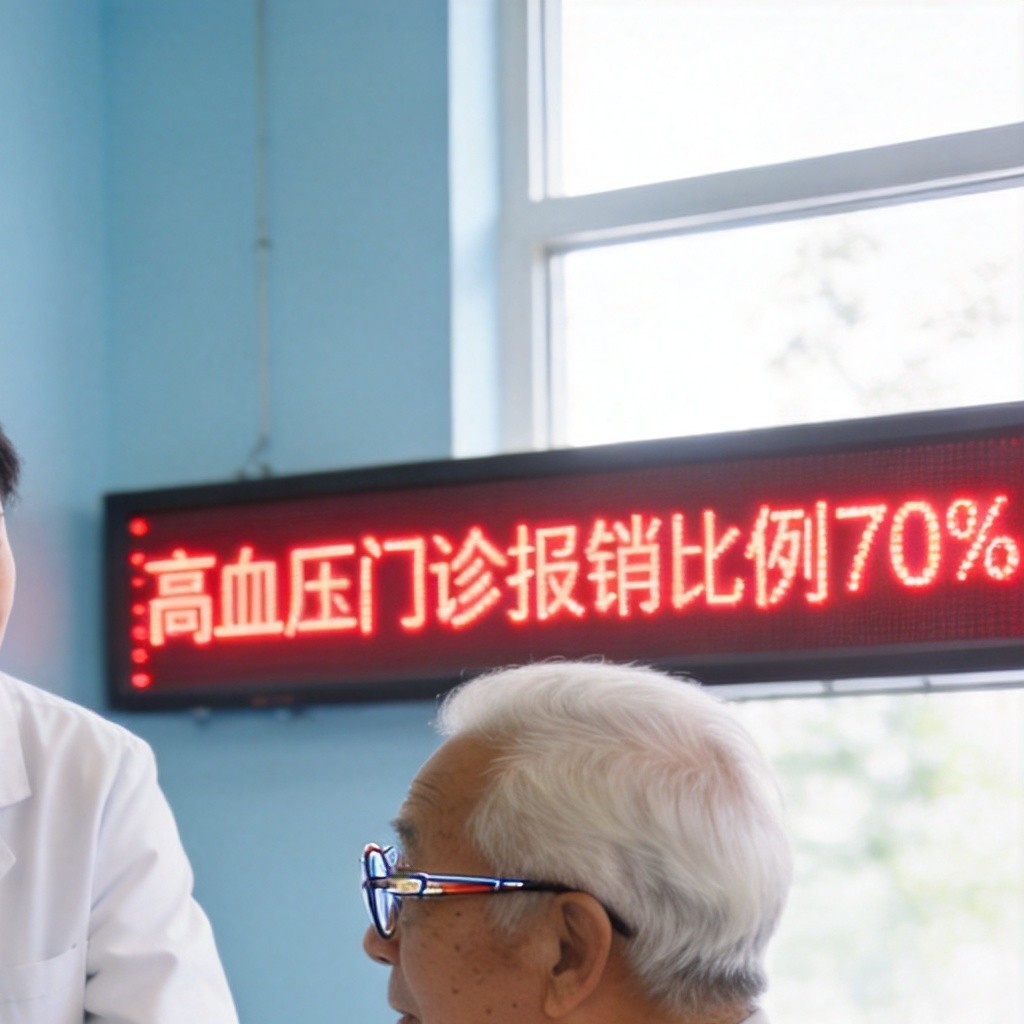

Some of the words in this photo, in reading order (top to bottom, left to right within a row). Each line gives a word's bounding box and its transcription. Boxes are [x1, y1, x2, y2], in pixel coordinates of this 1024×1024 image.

[145, 495, 1020, 647] 高血压门诊报销比例70%
